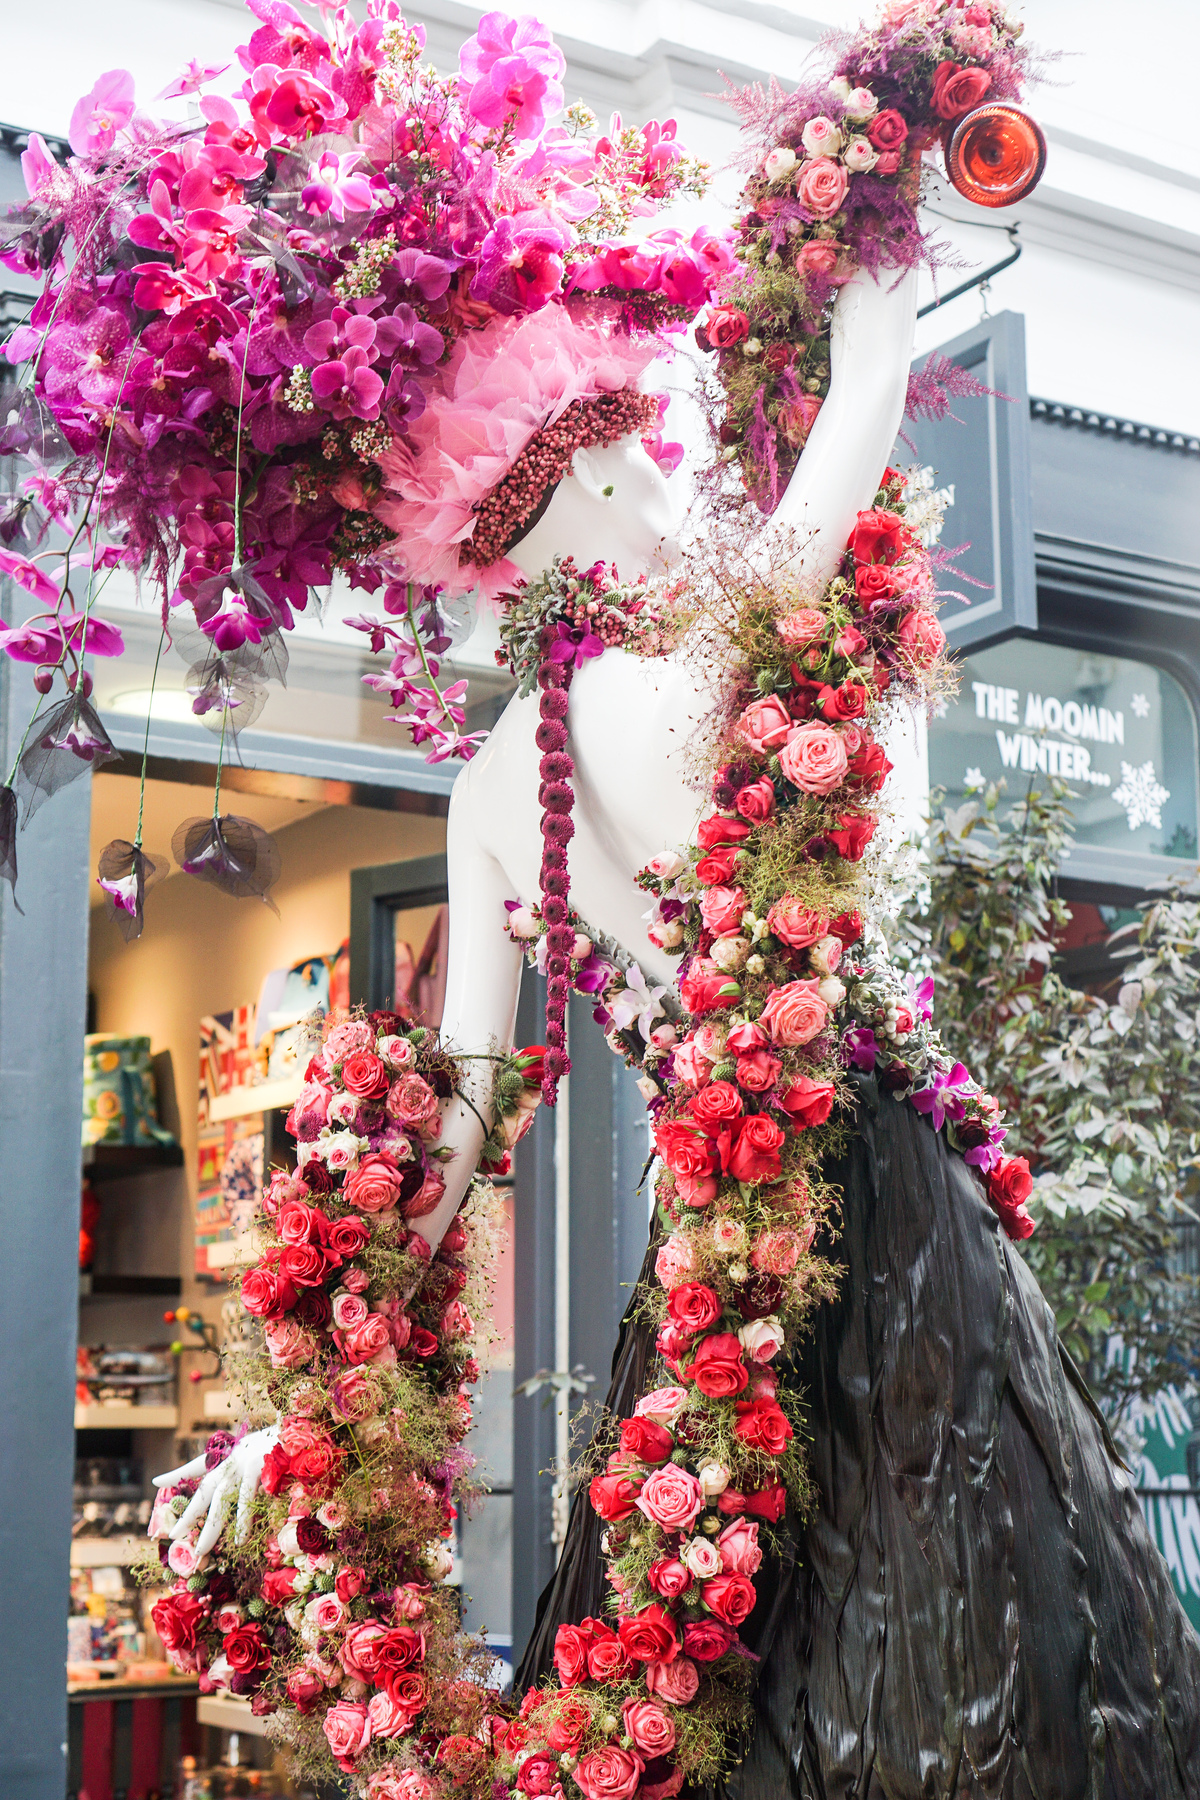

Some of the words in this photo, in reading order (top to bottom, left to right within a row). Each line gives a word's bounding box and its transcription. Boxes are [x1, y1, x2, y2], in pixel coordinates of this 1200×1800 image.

[972, 681, 1019, 725] THE
[1024, 691, 1125, 746] MOOMIN
[996, 729, 1111, 787] WINTER...
